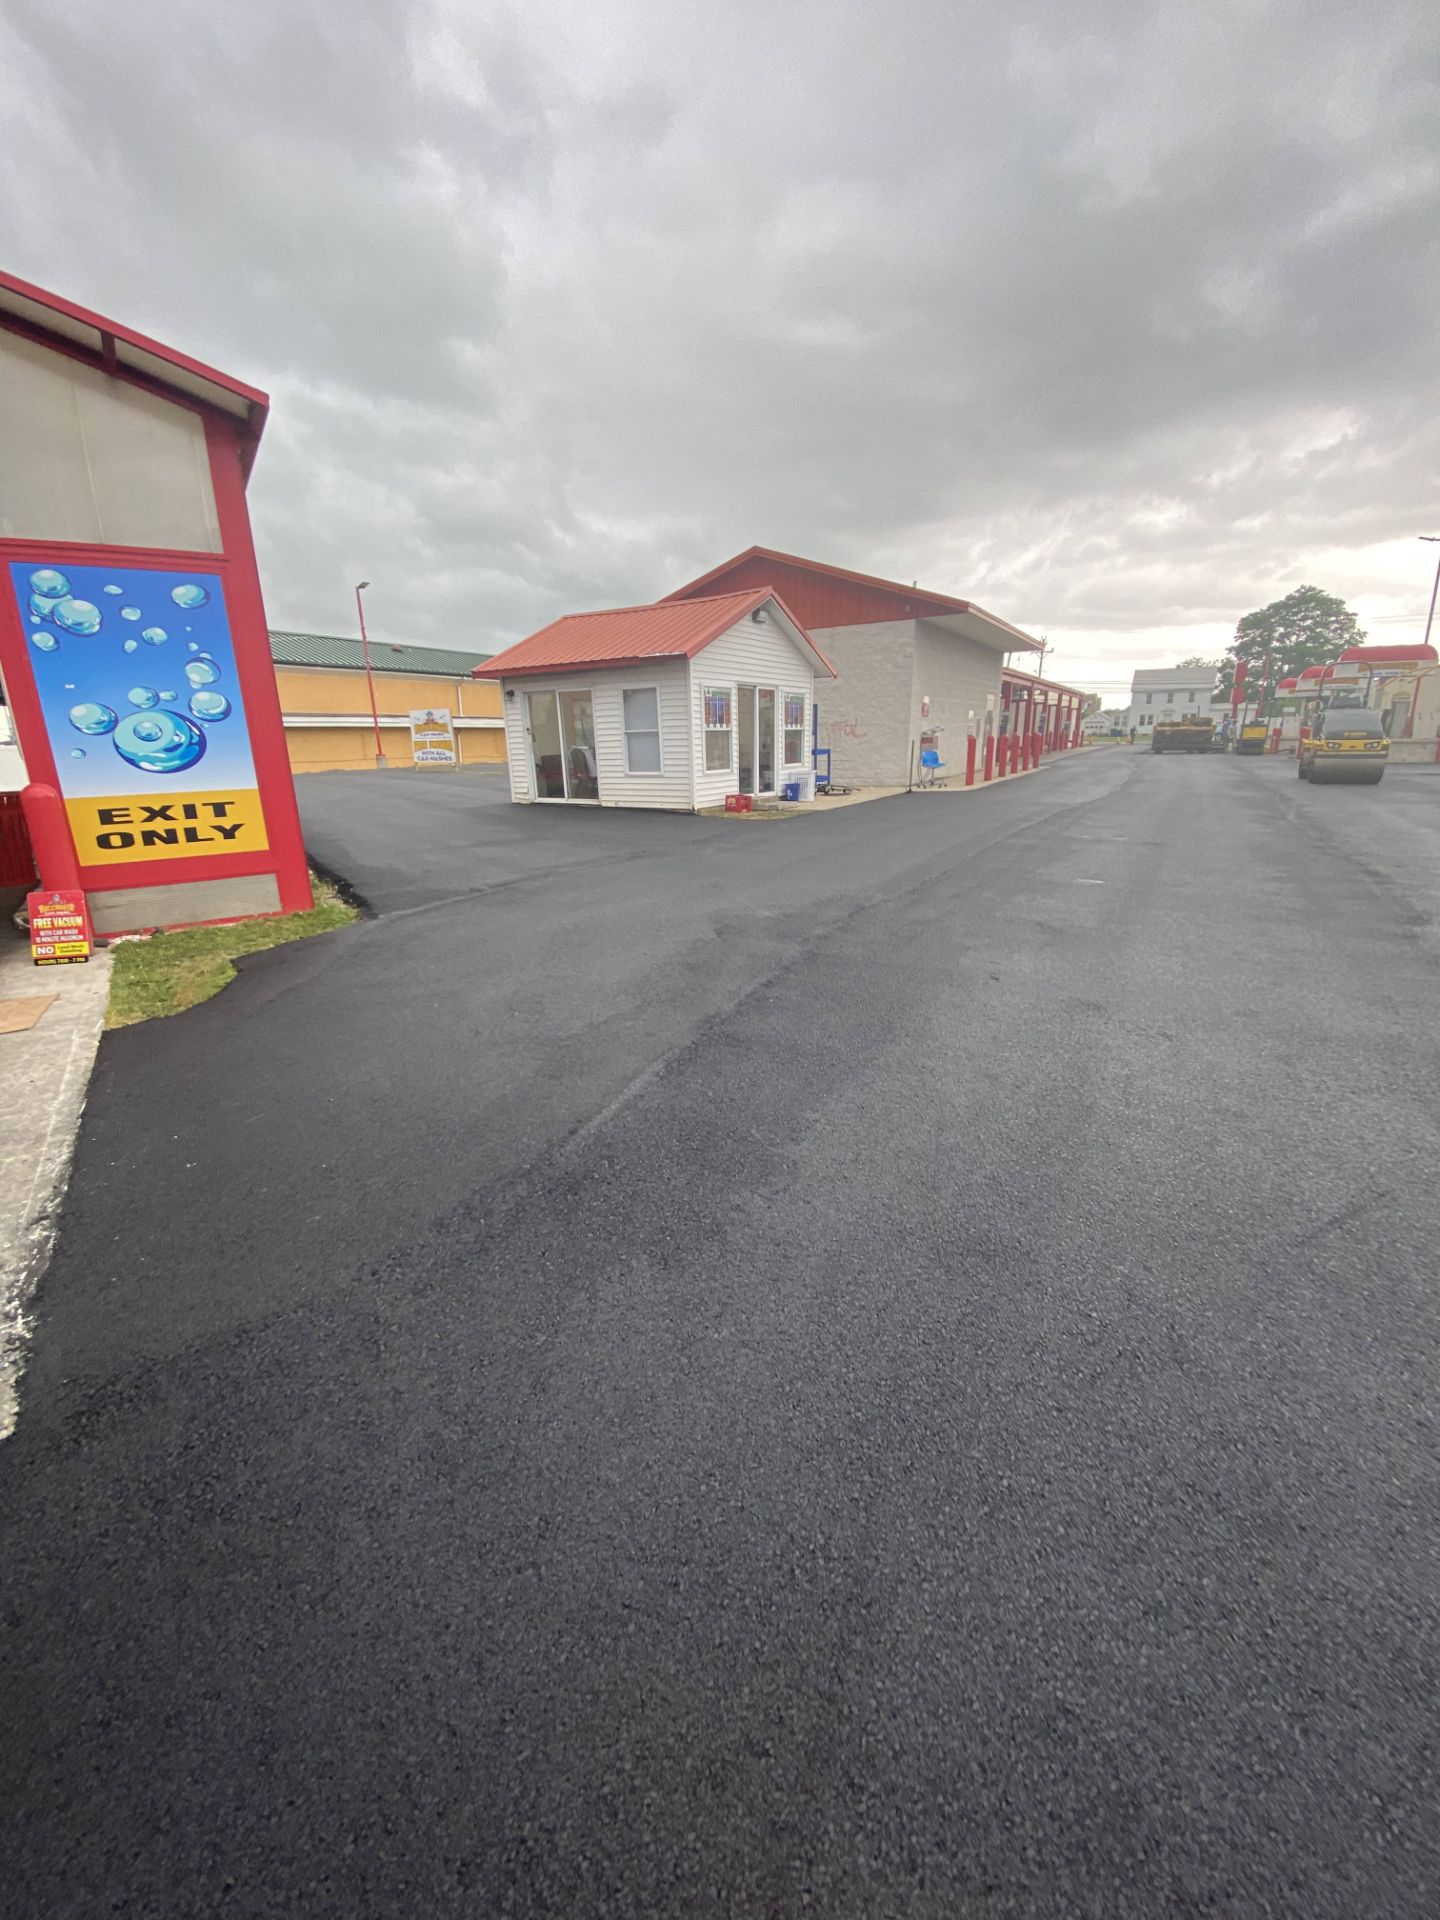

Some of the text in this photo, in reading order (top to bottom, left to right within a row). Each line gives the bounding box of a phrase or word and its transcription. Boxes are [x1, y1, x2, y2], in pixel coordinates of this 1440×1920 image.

[97, 801, 235, 826] EXIT
[96, 823, 245, 849] ONLY
[33, 916, 83, 929] FREE VACUUM
[37, 946, 54, 955] NO
